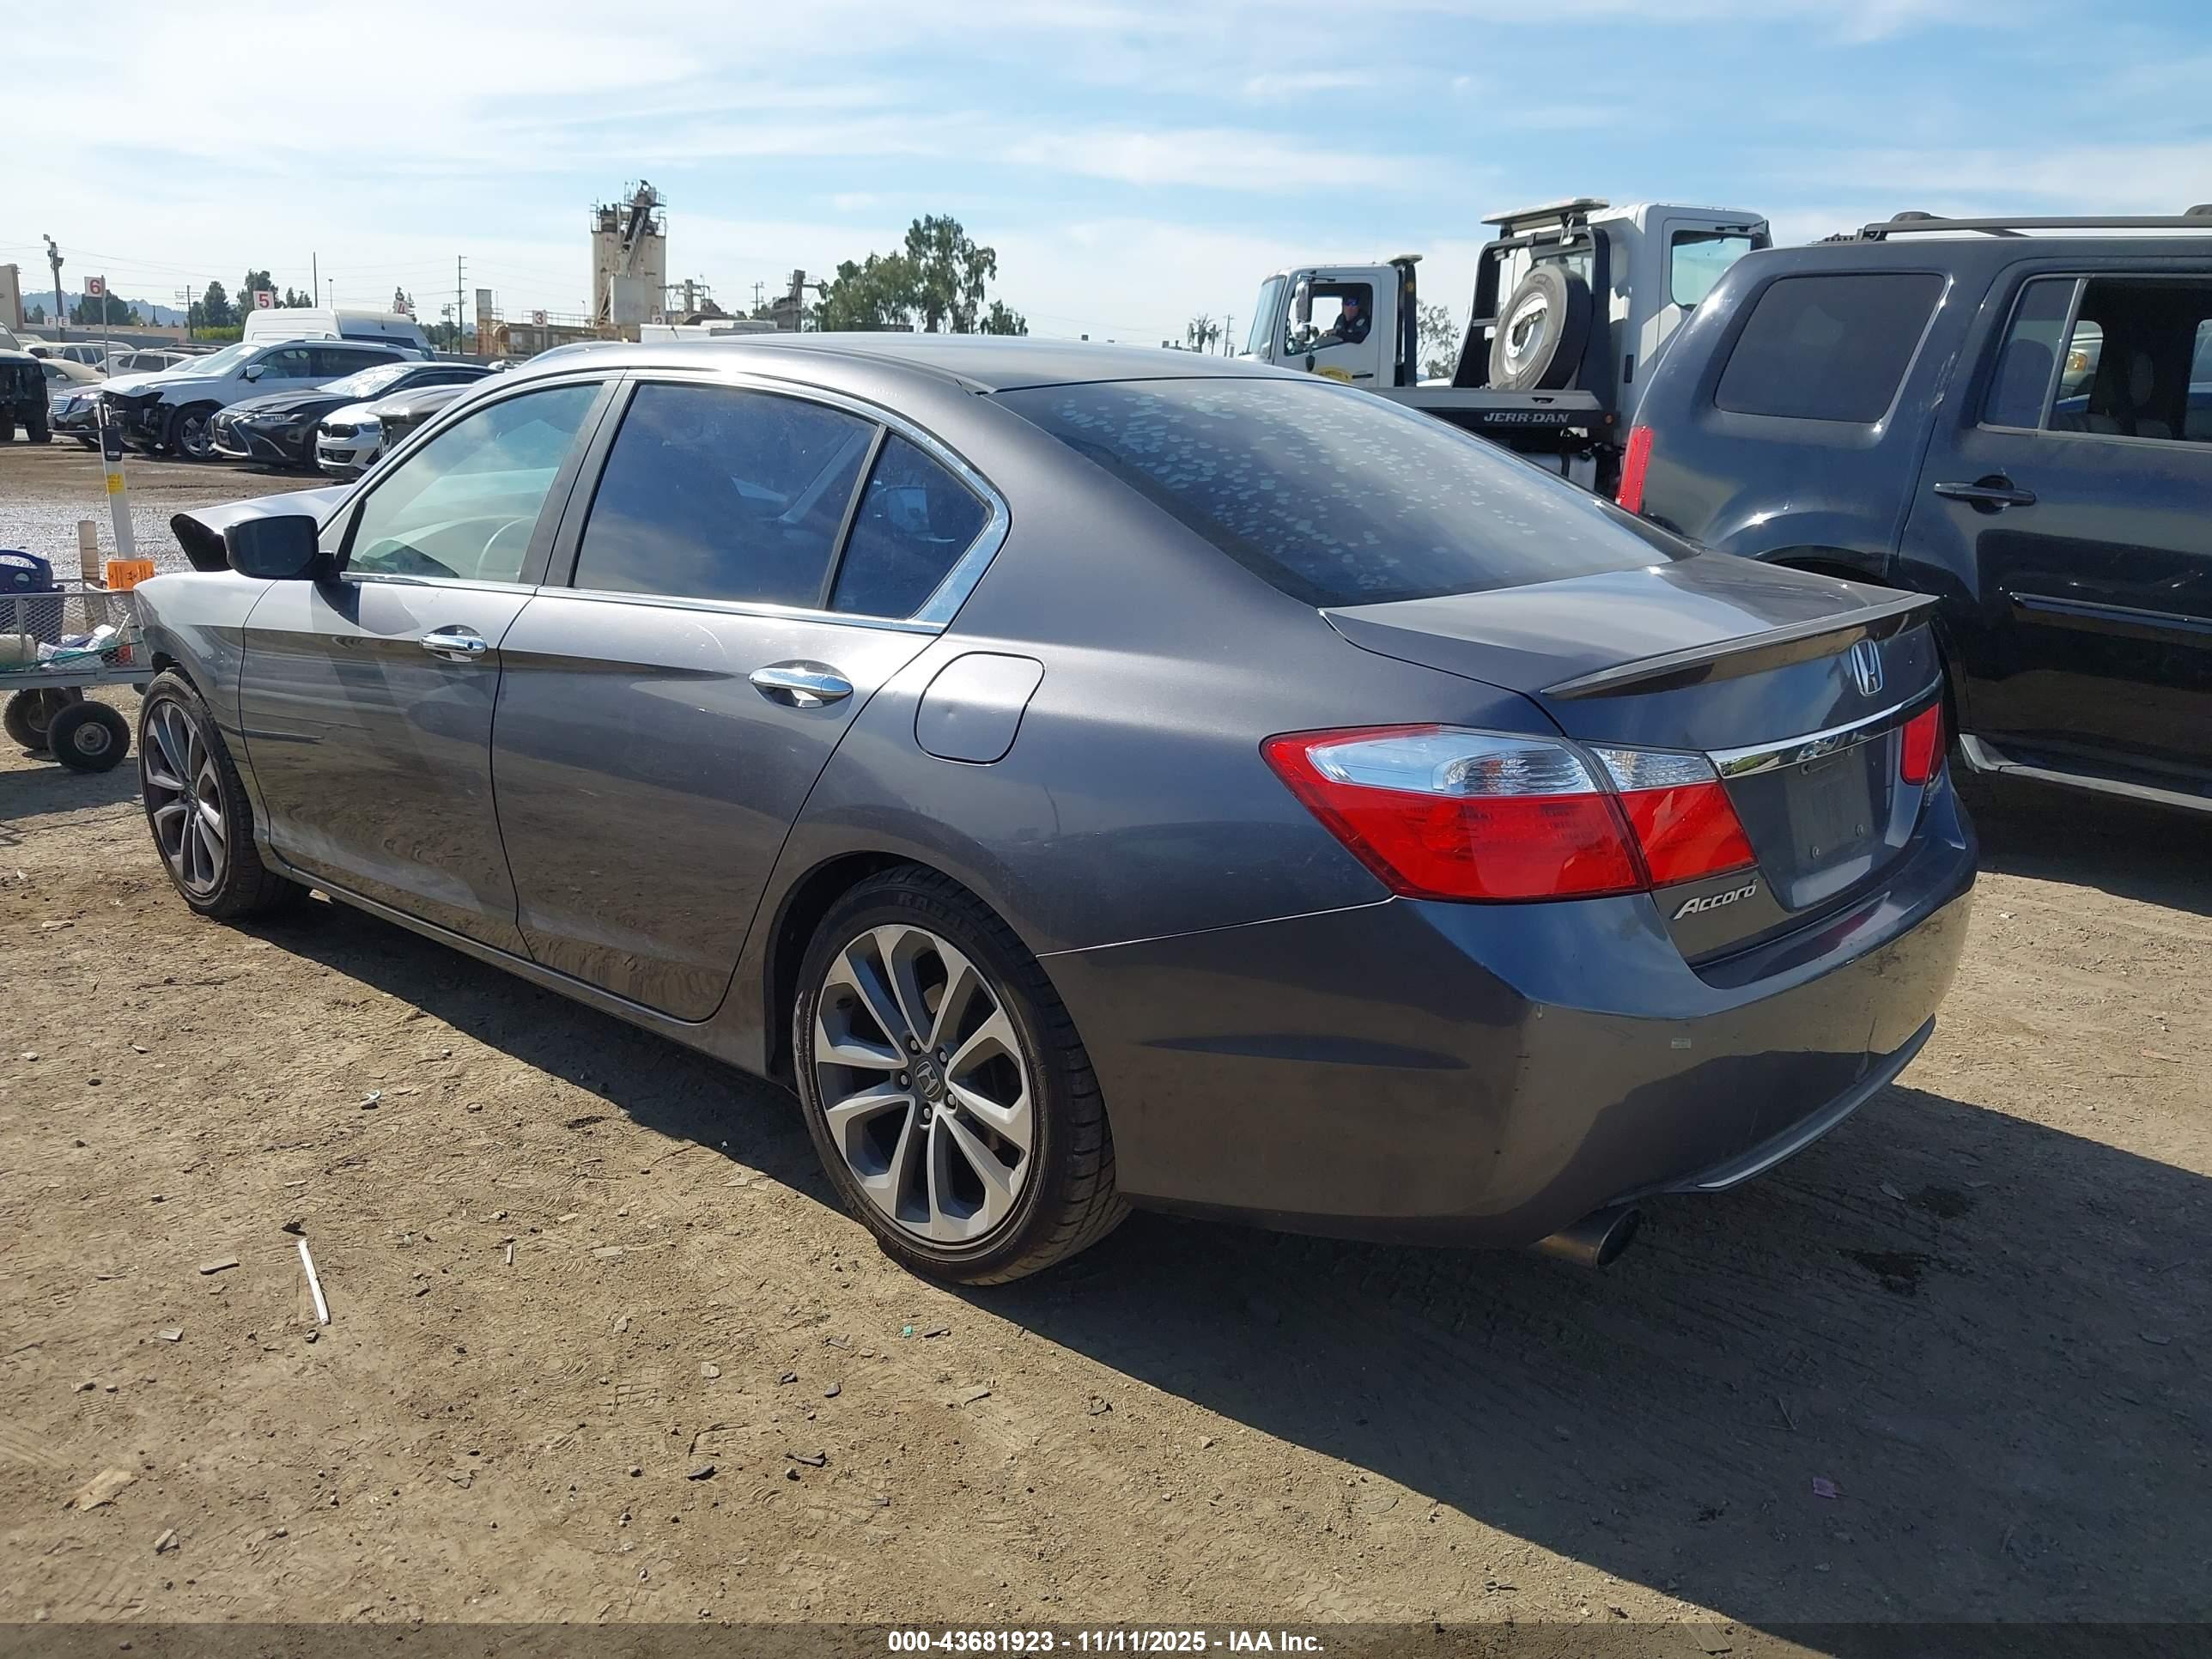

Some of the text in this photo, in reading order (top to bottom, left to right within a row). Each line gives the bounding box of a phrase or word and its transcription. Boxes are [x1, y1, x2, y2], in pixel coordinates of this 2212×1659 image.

[89, 279, 101, 295] 6
[258, 293, 270, 308] 5
[535, 312, 544, 325] 3
[1671, 878, 1759, 921] Accord
